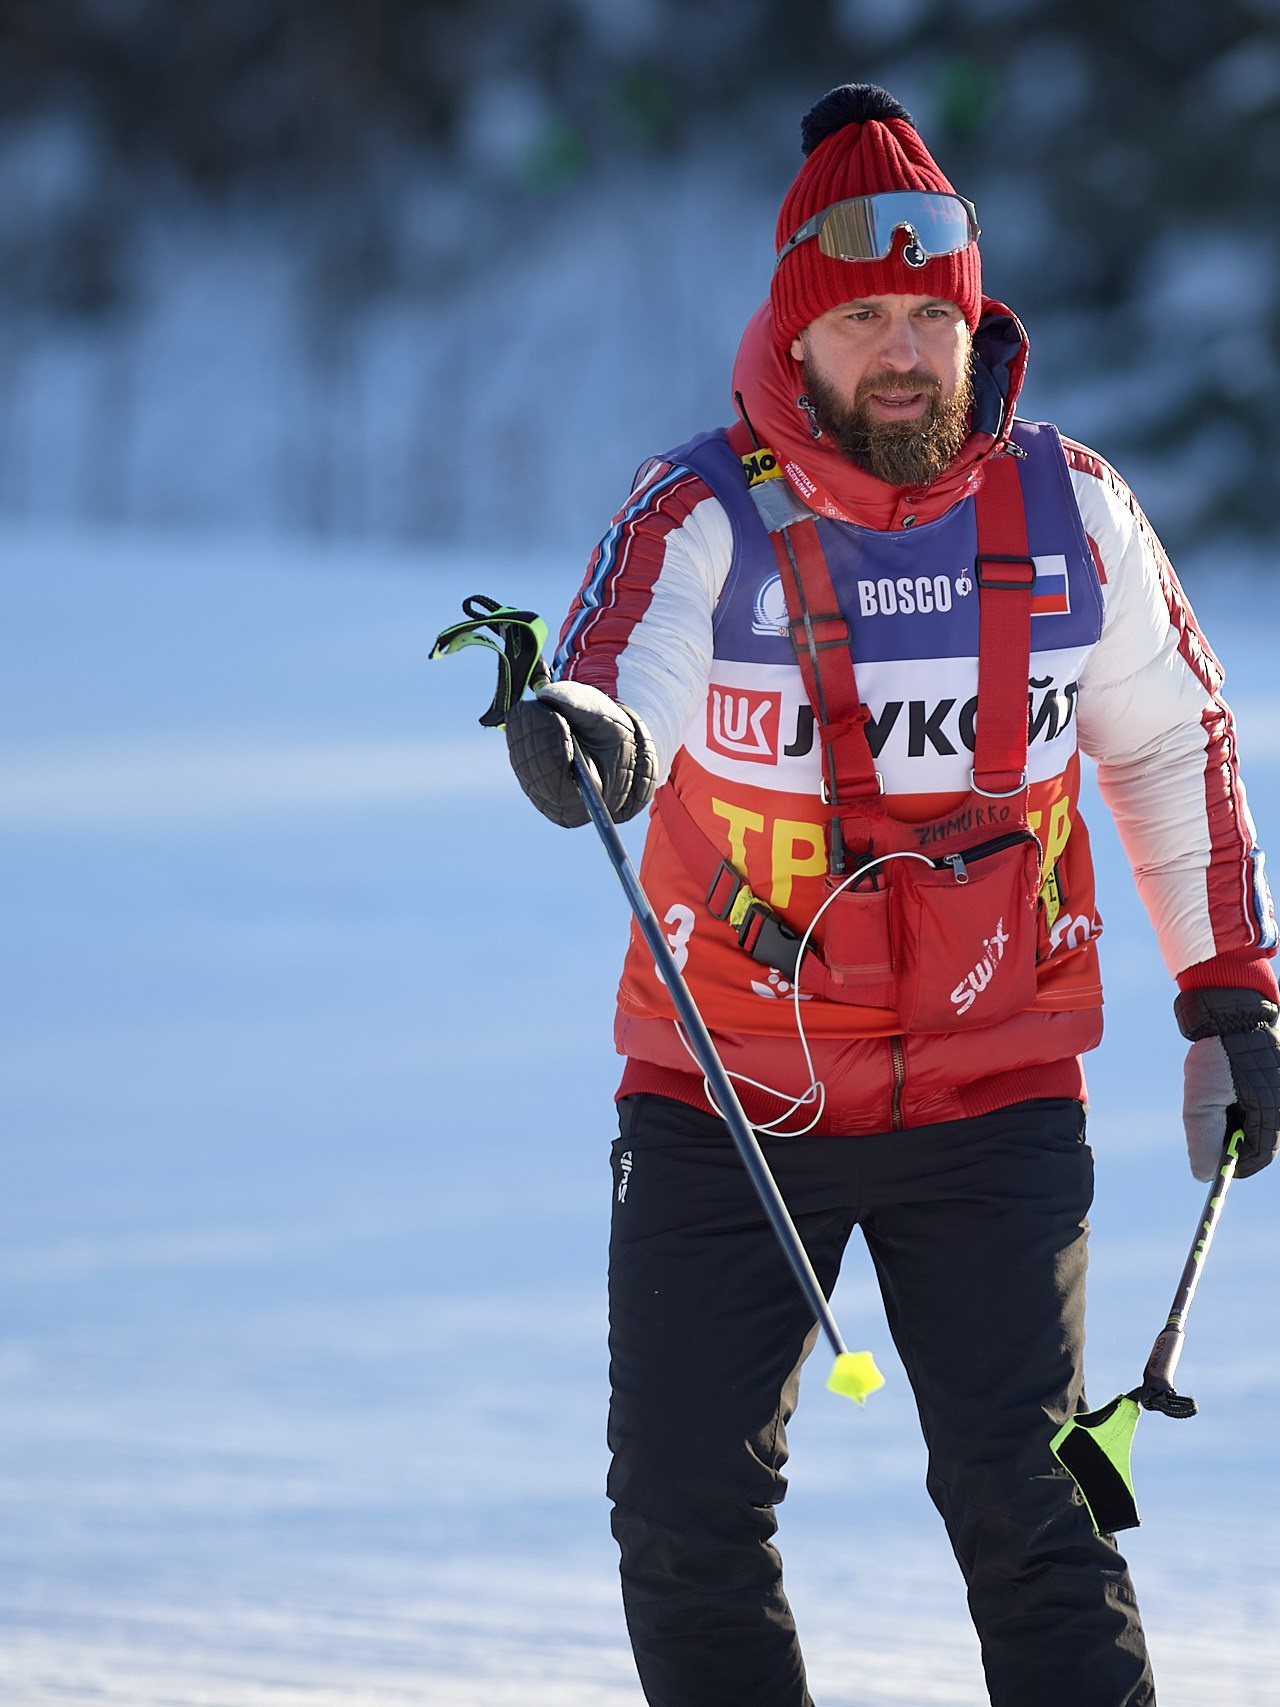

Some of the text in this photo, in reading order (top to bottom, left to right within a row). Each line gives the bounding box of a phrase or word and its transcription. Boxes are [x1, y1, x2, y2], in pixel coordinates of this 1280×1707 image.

[784, 463, 812, 499] РЕСПУБЛИКА
[857, 574, 953, 617] BOSCO
[914, 804, 1011, 847] ZHMURKO
